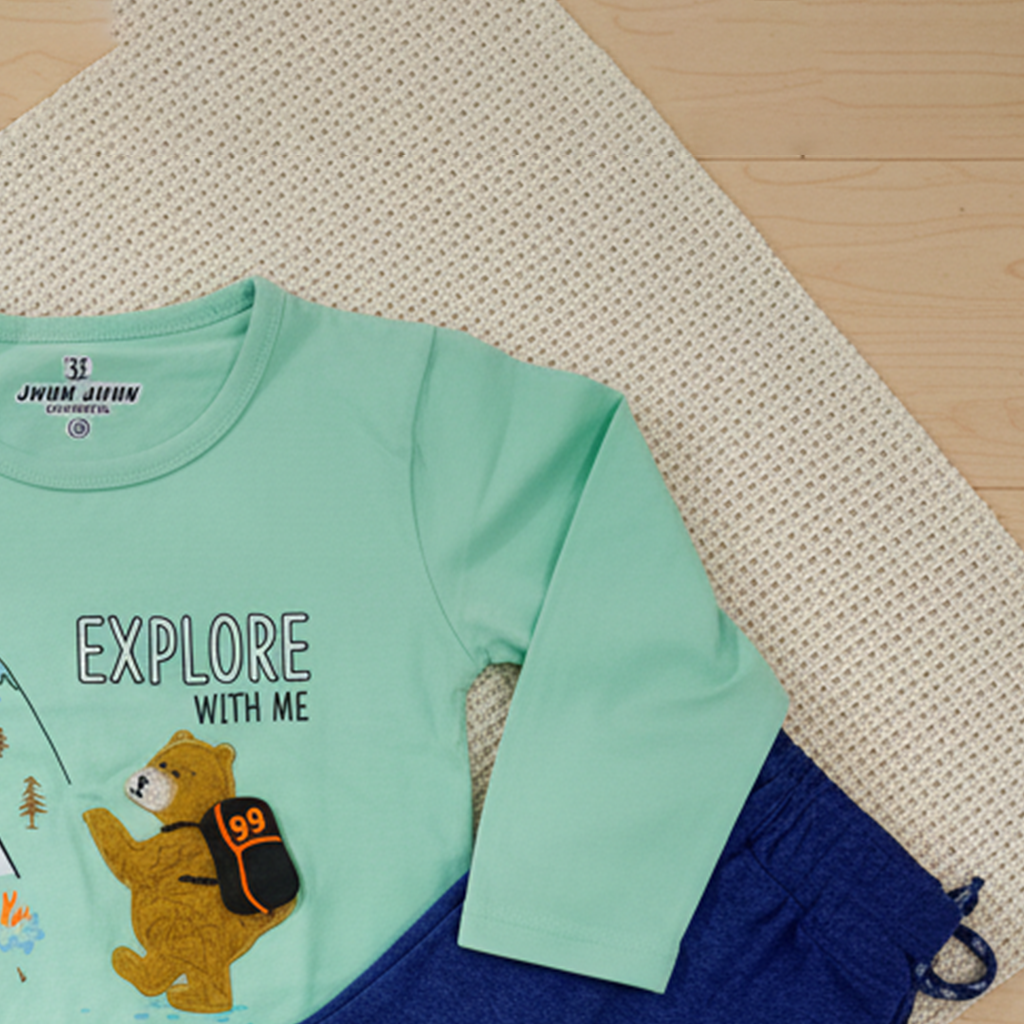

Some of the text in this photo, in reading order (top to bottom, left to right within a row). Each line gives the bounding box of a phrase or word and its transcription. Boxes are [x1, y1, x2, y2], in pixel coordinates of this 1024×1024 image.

[77, 612, 311, 685] EXPLORE
[194, 691, 309, 724] WITH ME
[229, 807, 266, 842] 99
